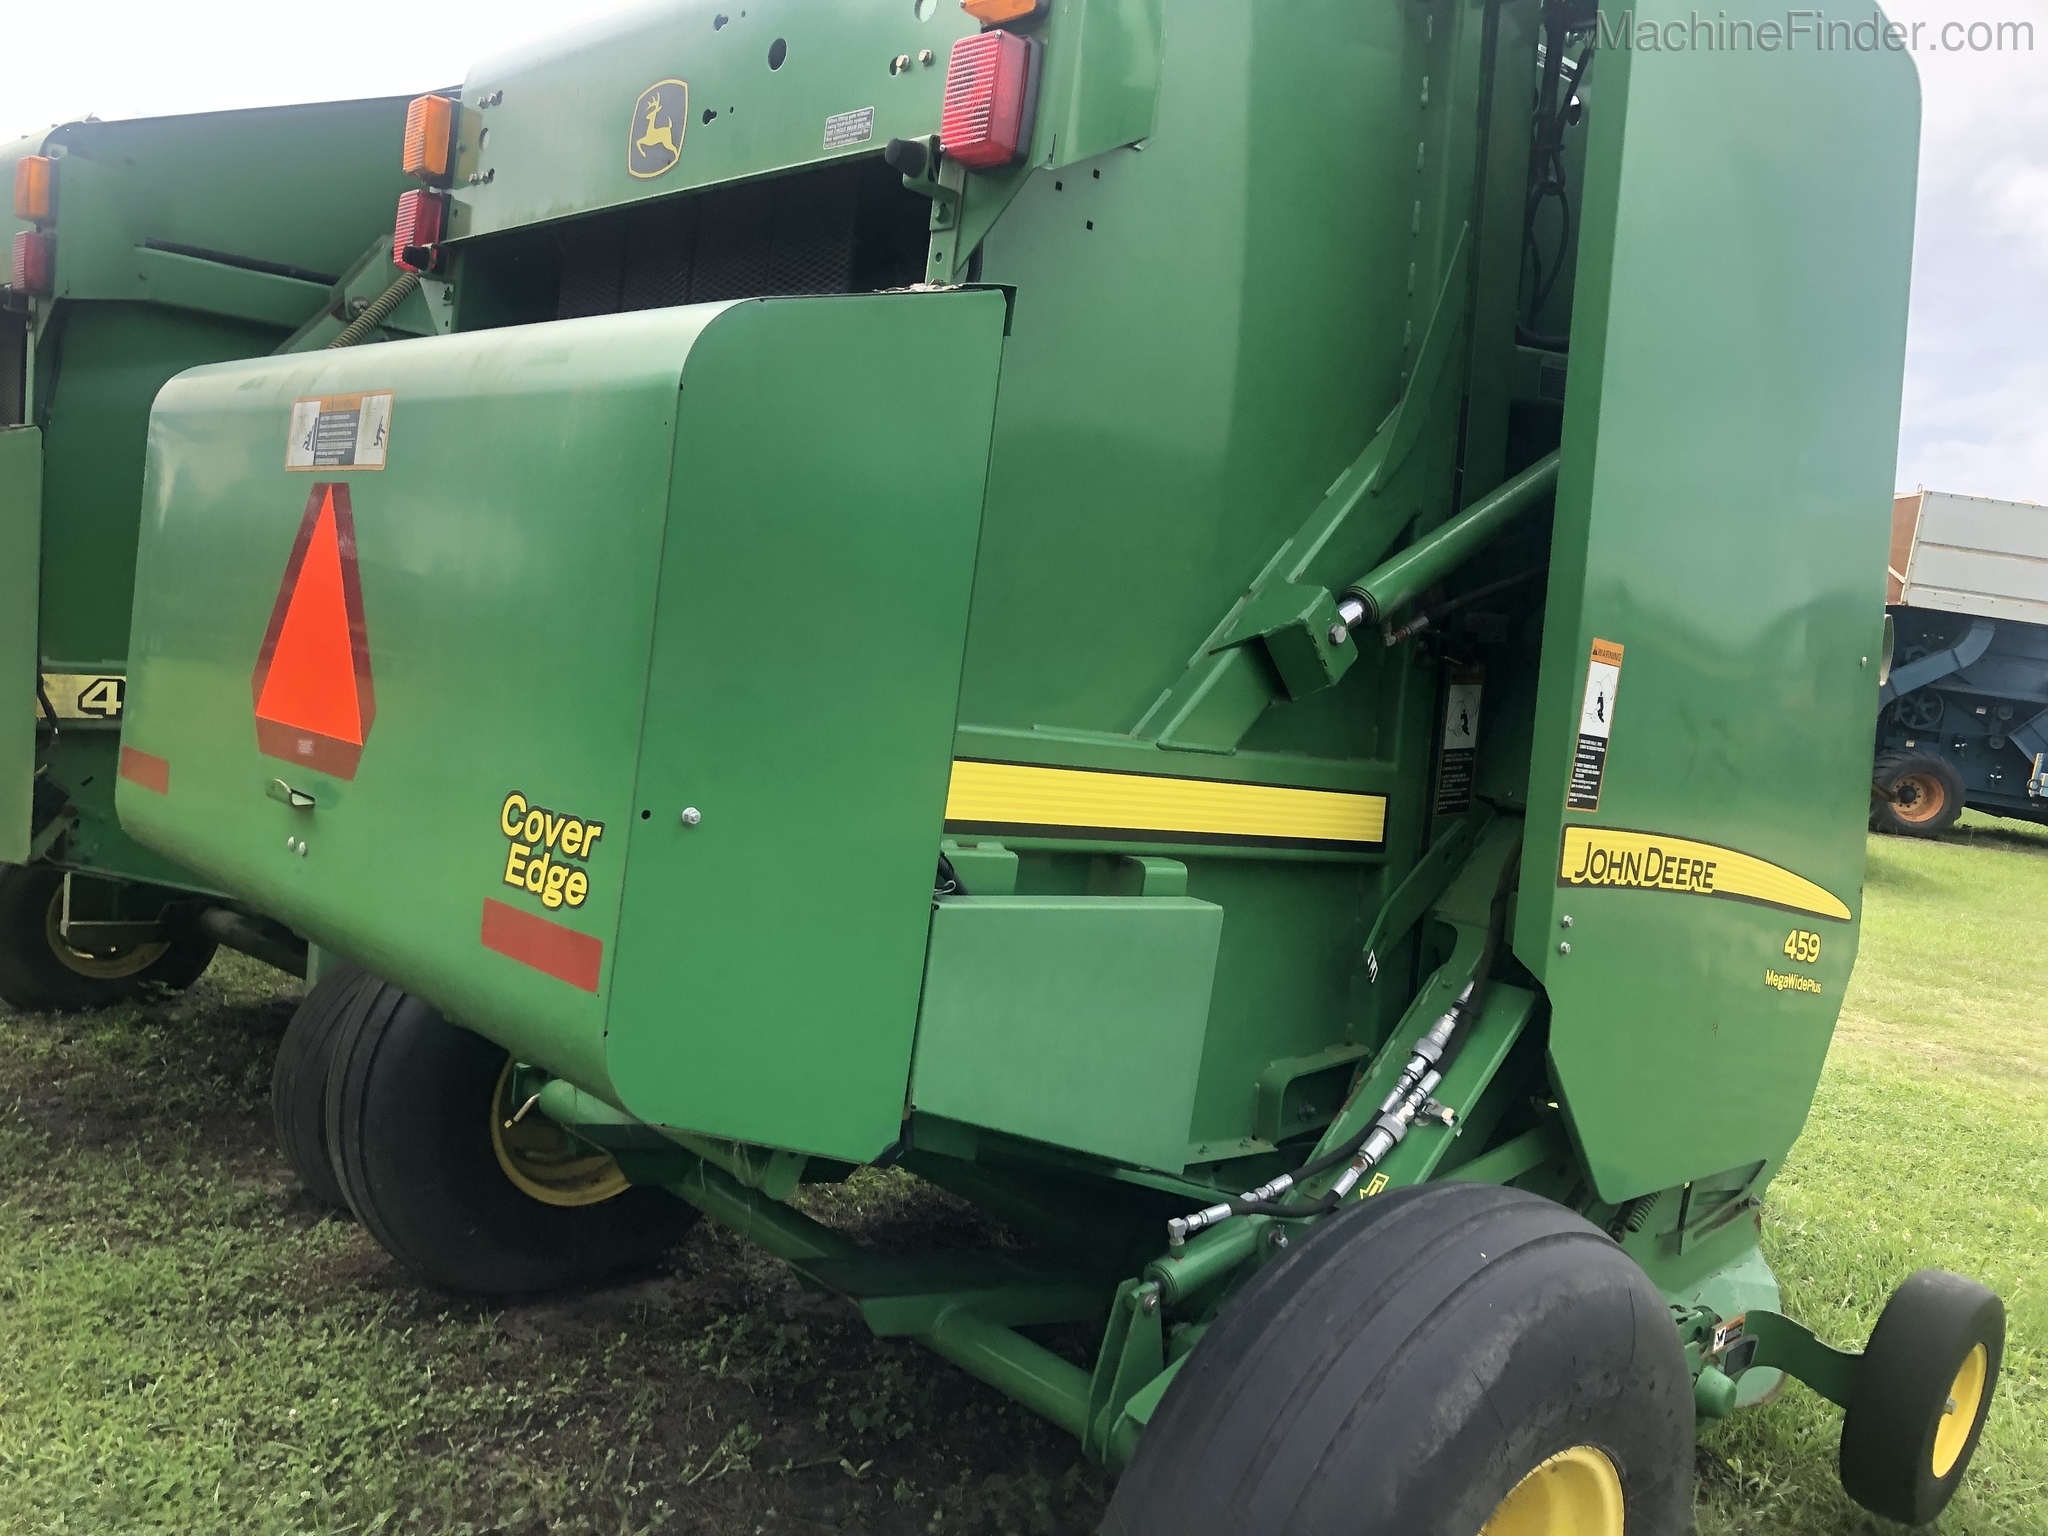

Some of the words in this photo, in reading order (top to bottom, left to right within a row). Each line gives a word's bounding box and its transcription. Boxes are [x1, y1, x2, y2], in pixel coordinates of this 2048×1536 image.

[501, 792, 603, 859] Cover
[504, 841, 589, 909] Edge
[1574, 841, 1643, 880] JOHN
[1643, 847, 1717, 889] DEERE
[1784, 929, 1821, 963] 459
